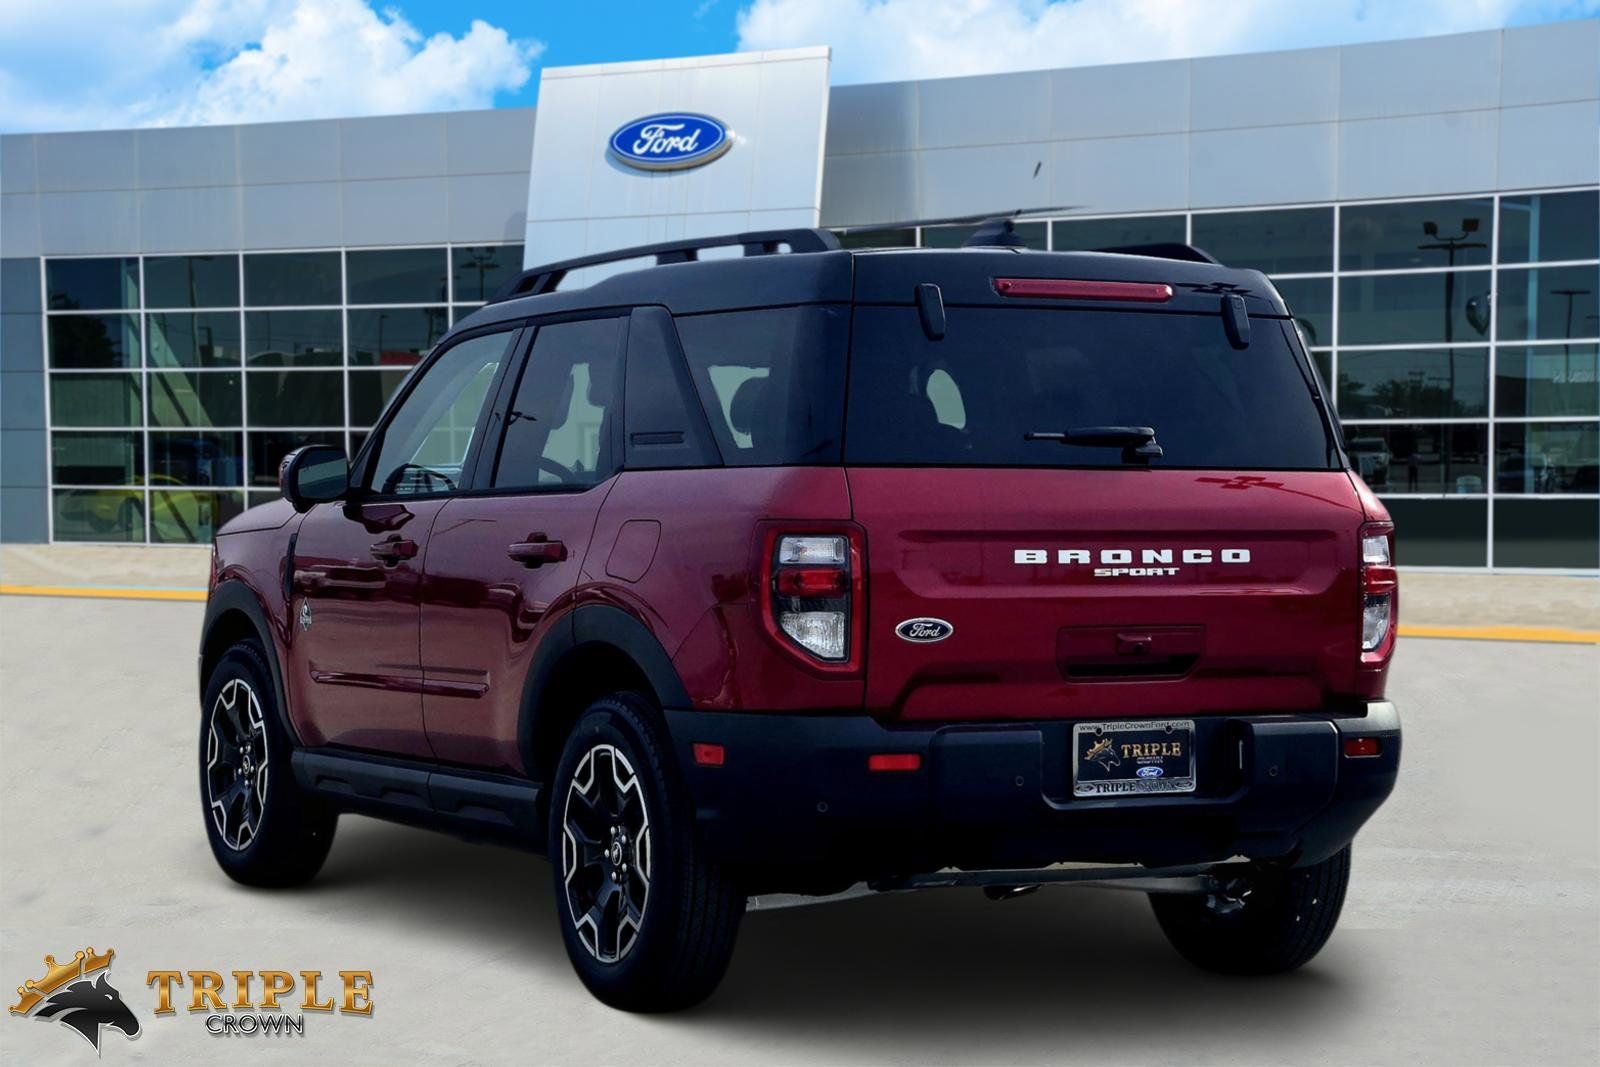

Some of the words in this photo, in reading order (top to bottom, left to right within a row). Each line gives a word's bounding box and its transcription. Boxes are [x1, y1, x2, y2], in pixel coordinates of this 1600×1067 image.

[632, 123, 702, 155] Ford
[1014, 549, 1251, 564] BRONCO
[1093, 567, 1180, 577] SPORT
[909, 622, 941, 637] Ford
[1121, 742, 1182, 758] TRIPLE
[1095, 782, 1136, 793] TRIPLE
